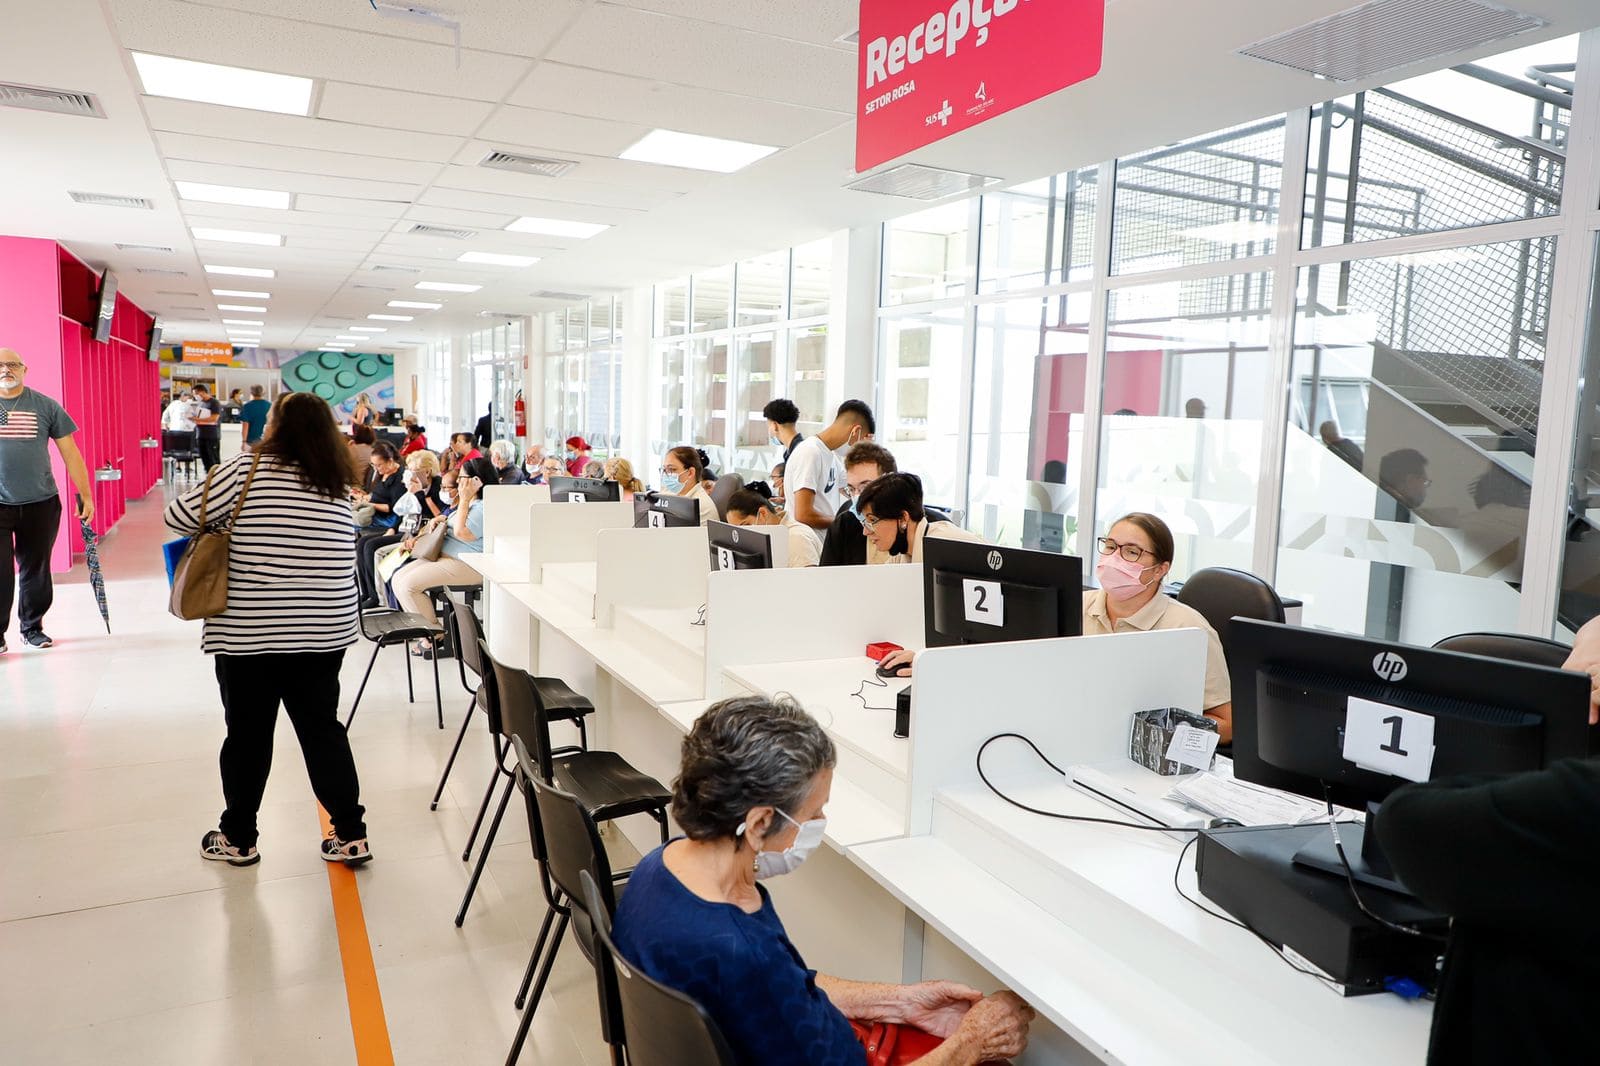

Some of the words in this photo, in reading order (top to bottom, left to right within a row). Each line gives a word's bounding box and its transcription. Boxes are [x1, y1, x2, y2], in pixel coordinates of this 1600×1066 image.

[866, 0, 1031, 89] Recepç
[865, 92, 891, 115] SETOR
[892, 79, 915, 101] ROSA
[925, 113, 937, 126] SUS
[661, 499, 669, 507] LG
[652, 515, 658, 527] 4
[723, 551, 729, 568] 3
[988, 550, 1002, 570] hp
[973, 585, 989, 612] 2
[1375, 651, 1406, 681] hp
[1379, 715, 1408, 757] 1
